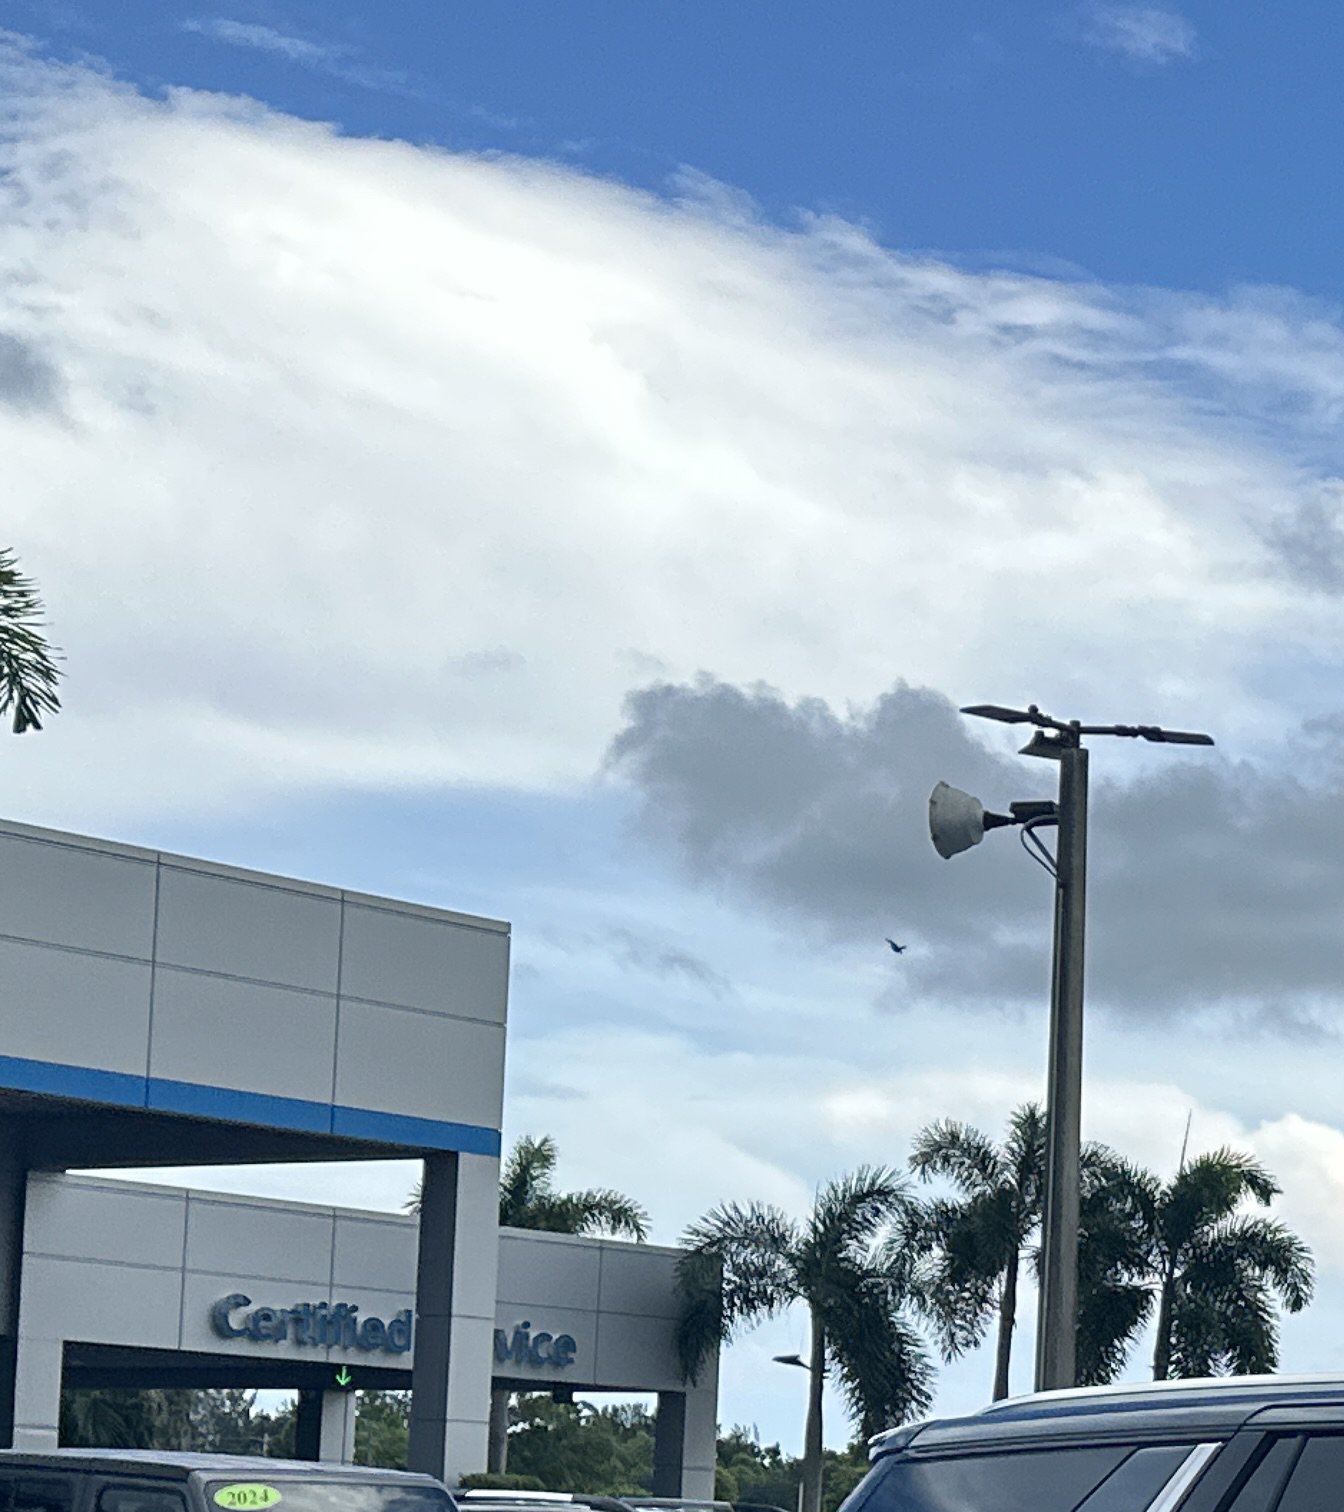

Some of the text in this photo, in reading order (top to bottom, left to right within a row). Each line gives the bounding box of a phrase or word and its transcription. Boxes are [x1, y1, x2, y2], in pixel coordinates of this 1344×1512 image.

[210, 1291, 577, 1366] Certified vice
[226, 1488, 269, 1506] 2024
